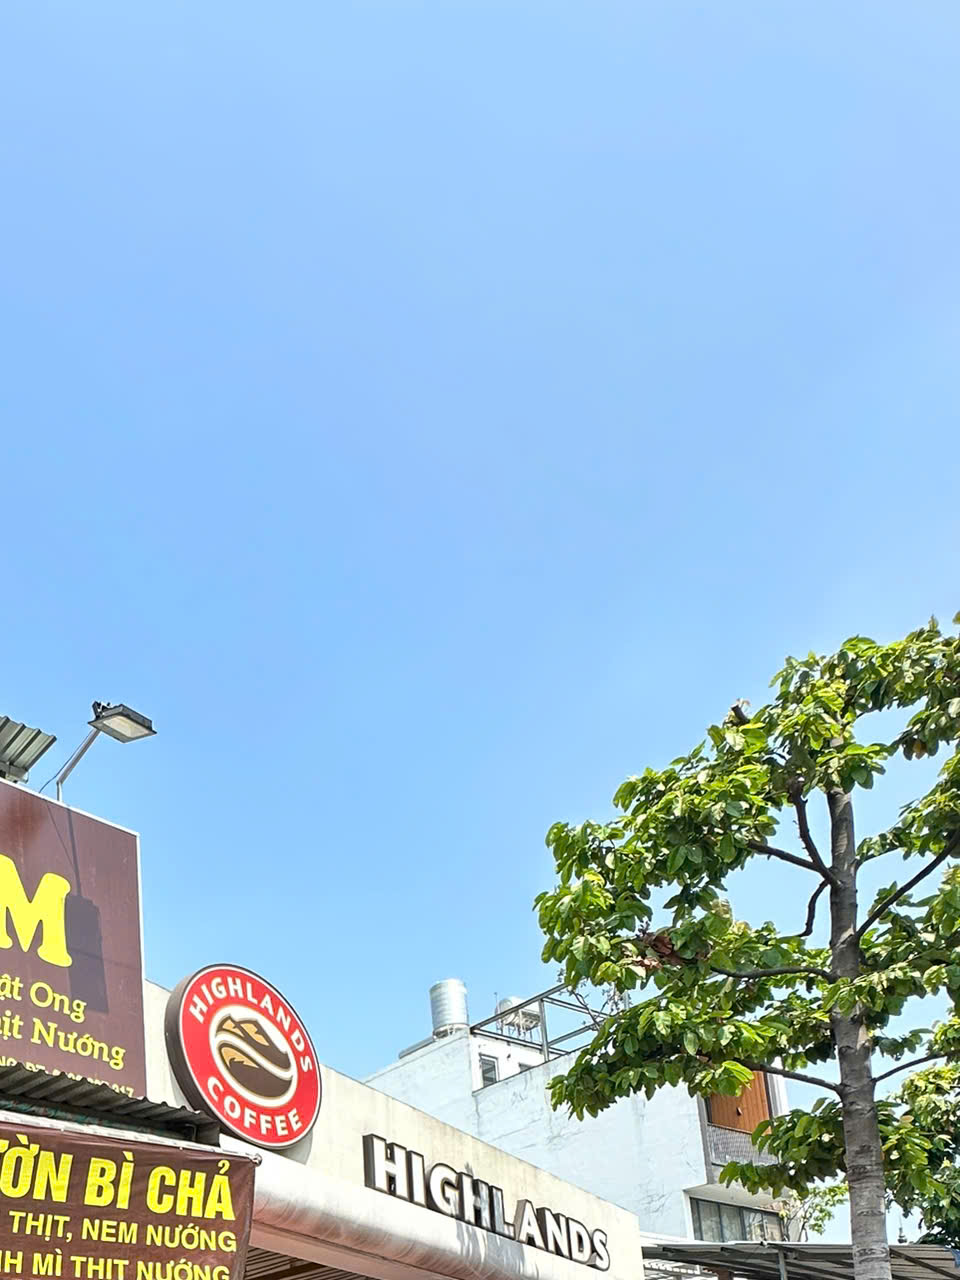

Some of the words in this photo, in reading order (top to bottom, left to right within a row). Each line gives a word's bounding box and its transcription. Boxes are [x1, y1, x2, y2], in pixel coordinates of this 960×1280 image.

[30, 981, 87, 1024] Ong
[189, 976, 314, 1074] HIGHLANDS
[30, 1017, 127, 1071] Nướng
[207, 1076, 303, 1137] COFFEE
[83, 1150, 136, 1210] BÌ
[146, 1158, 236, 1221] CHẢ
[363, 1133, 611, 1271] HIGHLANDS
[8, 1210, 72, 1243] THỊT,
[81, 1219, 138, 1245] NEM
[145, 1224, 237, 1253] NƯỚNG
[31, 1248, 63, 1277] MÌ
